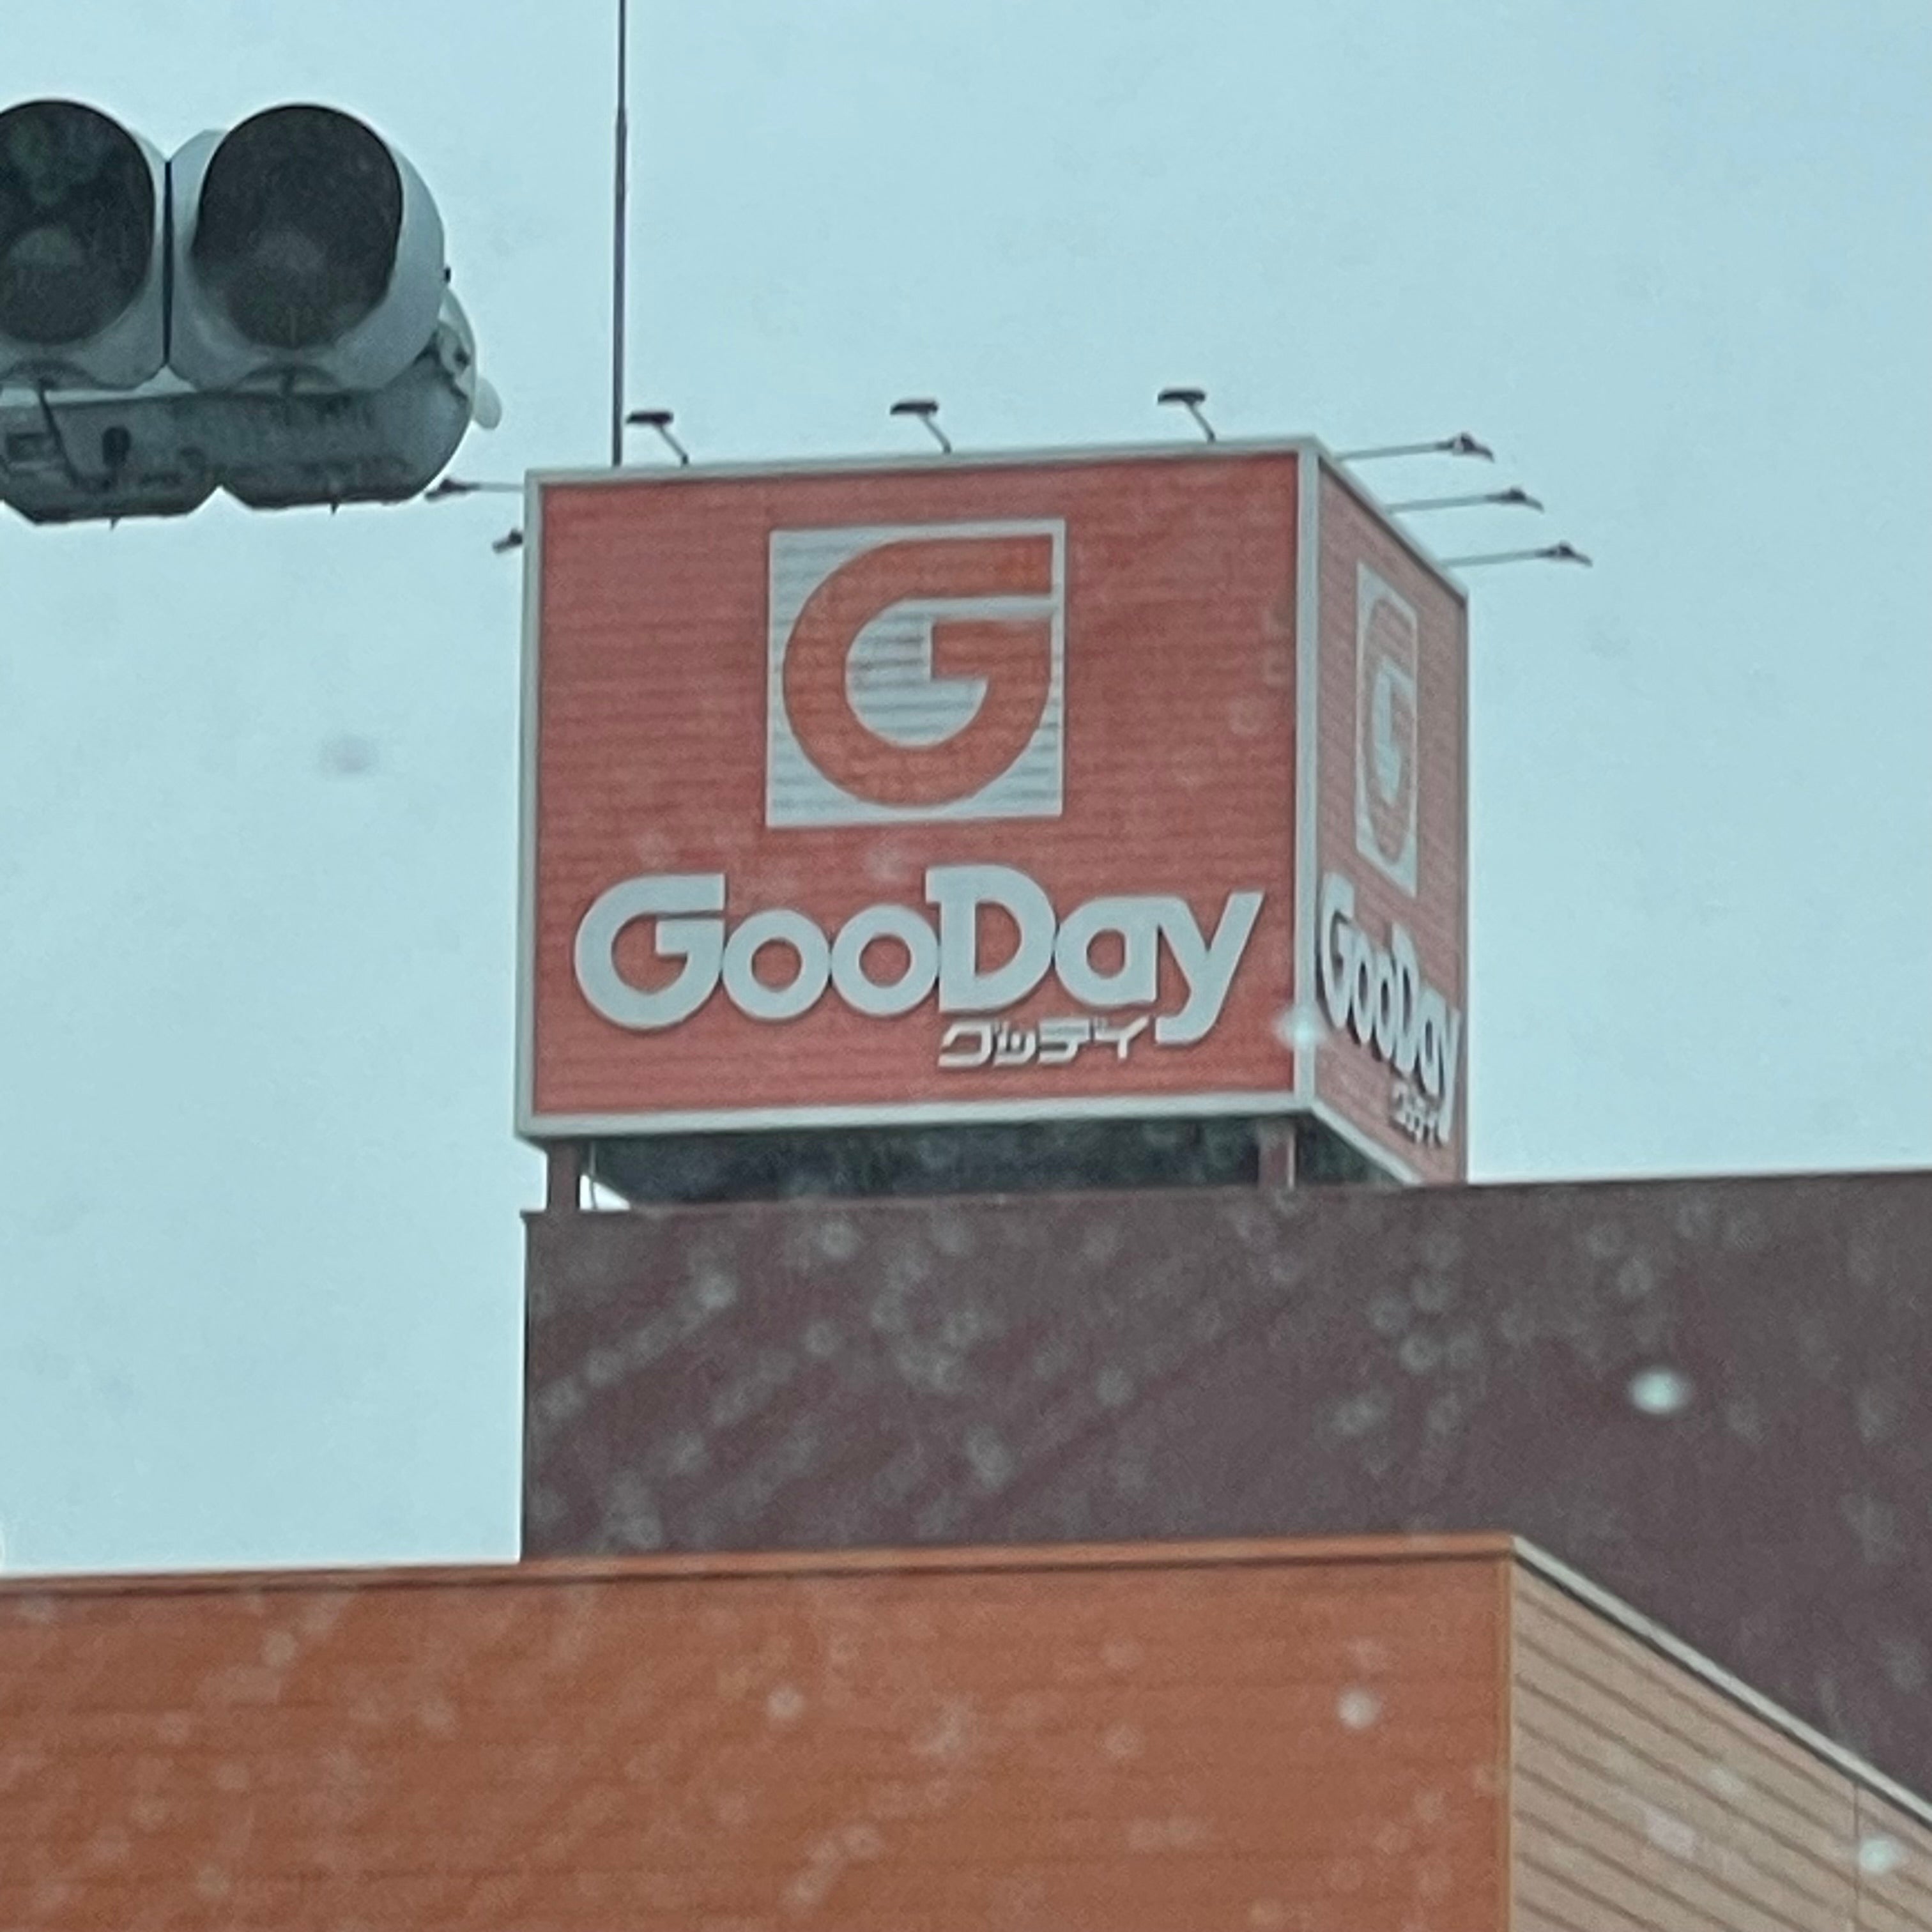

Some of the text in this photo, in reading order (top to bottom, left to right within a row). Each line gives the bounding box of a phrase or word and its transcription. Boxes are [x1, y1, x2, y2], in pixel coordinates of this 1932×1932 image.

[783, 535, 1052, 808] G
[575, 864, 1264, 1044] GooDay
[1321, 872, 1460, 1143] GooDay
